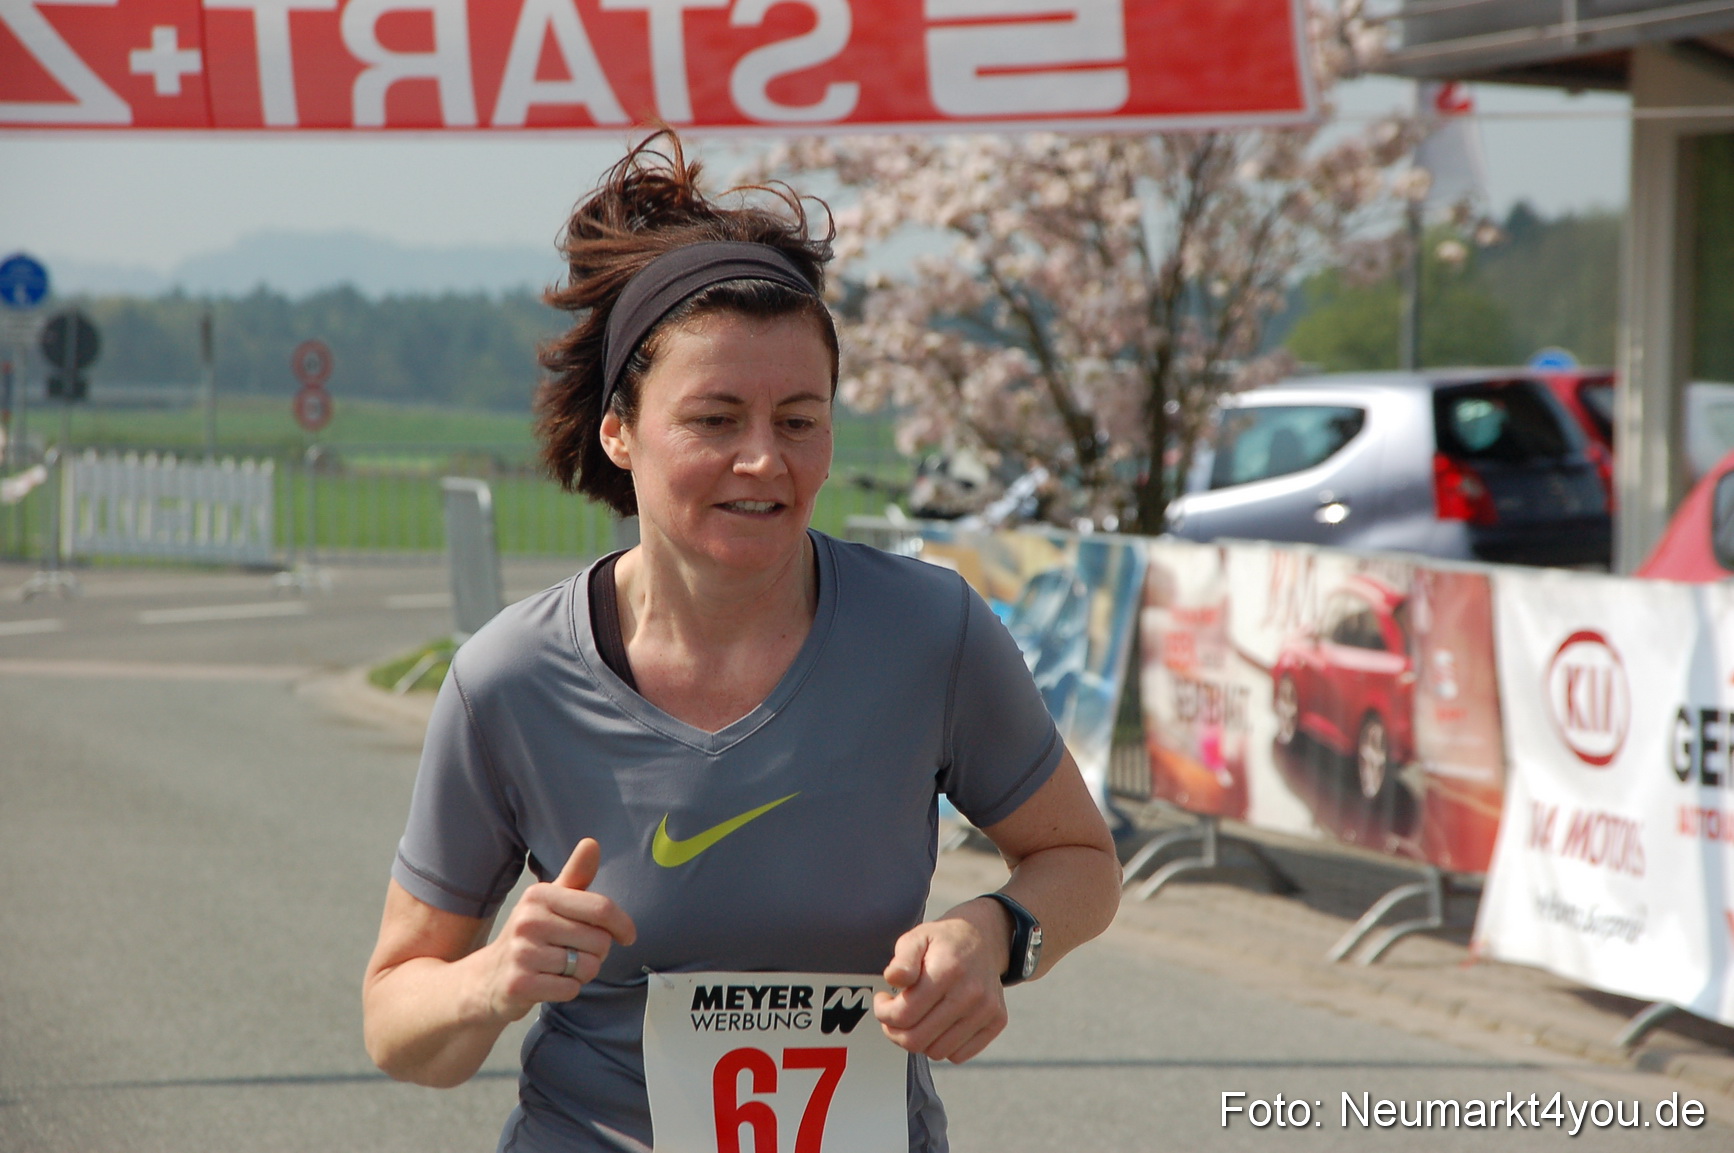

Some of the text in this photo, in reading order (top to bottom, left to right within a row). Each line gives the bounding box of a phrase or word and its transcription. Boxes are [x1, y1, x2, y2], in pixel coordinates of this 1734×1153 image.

[691, 985, 813, 1011] MEYER
[690, 1011, 813, 1032] WERBUNG
[712, 1046, 848, 1153] 67
